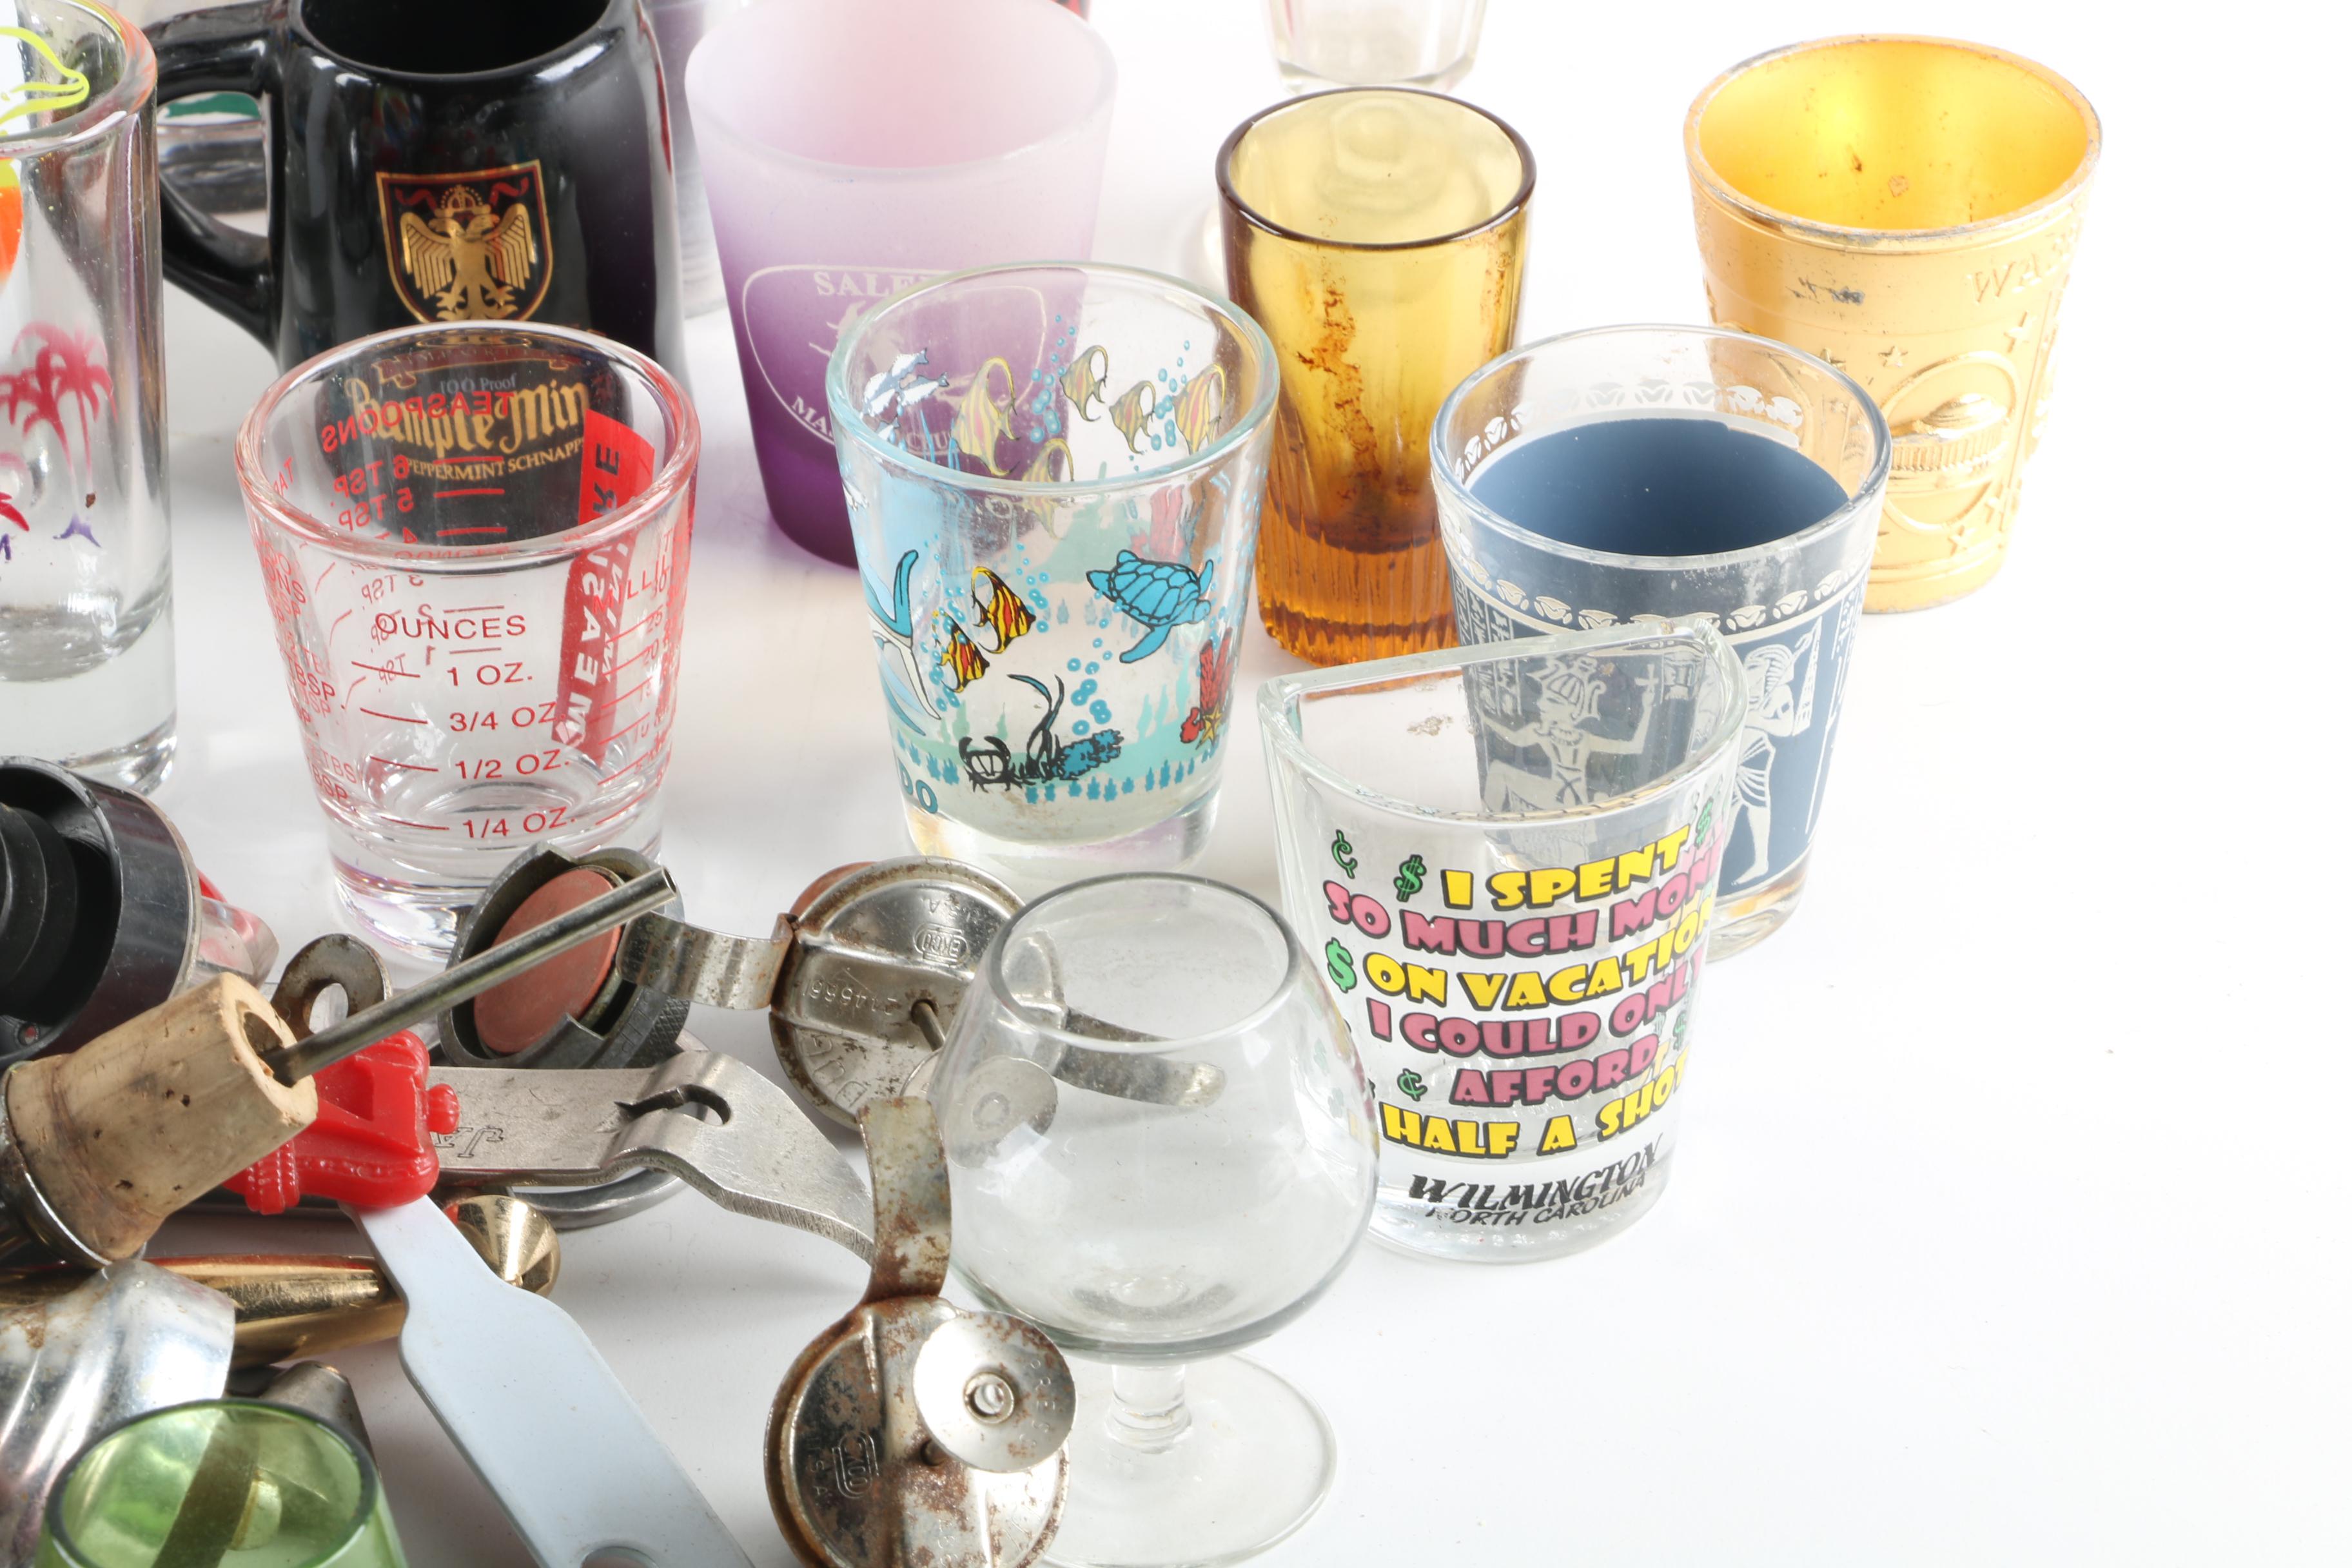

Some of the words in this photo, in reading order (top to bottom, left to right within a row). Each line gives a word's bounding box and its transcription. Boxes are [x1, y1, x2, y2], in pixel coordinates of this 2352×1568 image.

[813, 271, 928, 297] SALE
[480, 373, 517, 391] Proof
[495, 379, 589, 454] Min
[407, 458, 505, 481] PEPPERMINT
[508, 438, 586, 472] SCHNAPP
[375, 612, 526, 640] OUNCES
[447, 667, 458, 686] 1
[476, 662, 533, 685] OZ.
[449, 711, 498, 732] 3/4
[511, 701, 566, 727] OZ.
[455, 759, 502, 779] 1/2
[516, 749, 569, 775] OZ.
[462, 818, 509, 838] 1/4
[523, 807, 575, 833] OZ.
[1440, 868, 1473, 910] I
[1485, 823, 1690, 912] SPENT
[1322, 880, 1391, 939] SO
[1398, 908, 1599, 957] MUCH
[1362, 952, 1447, 1007] ON
[1366, 997, 1393, 1042] I
[1398, 1010, 1601, 1059] COULD
[1449, 1033, 1660, 1107] AFFORD
[1378, 1101, 1520, 1159] HALF
[1536, 1114, 1577, 1157] A
[1409, 1132, 1663, 1210] WILMINGTON
[1534, 1171, 1646, 1224] CAROLINA
